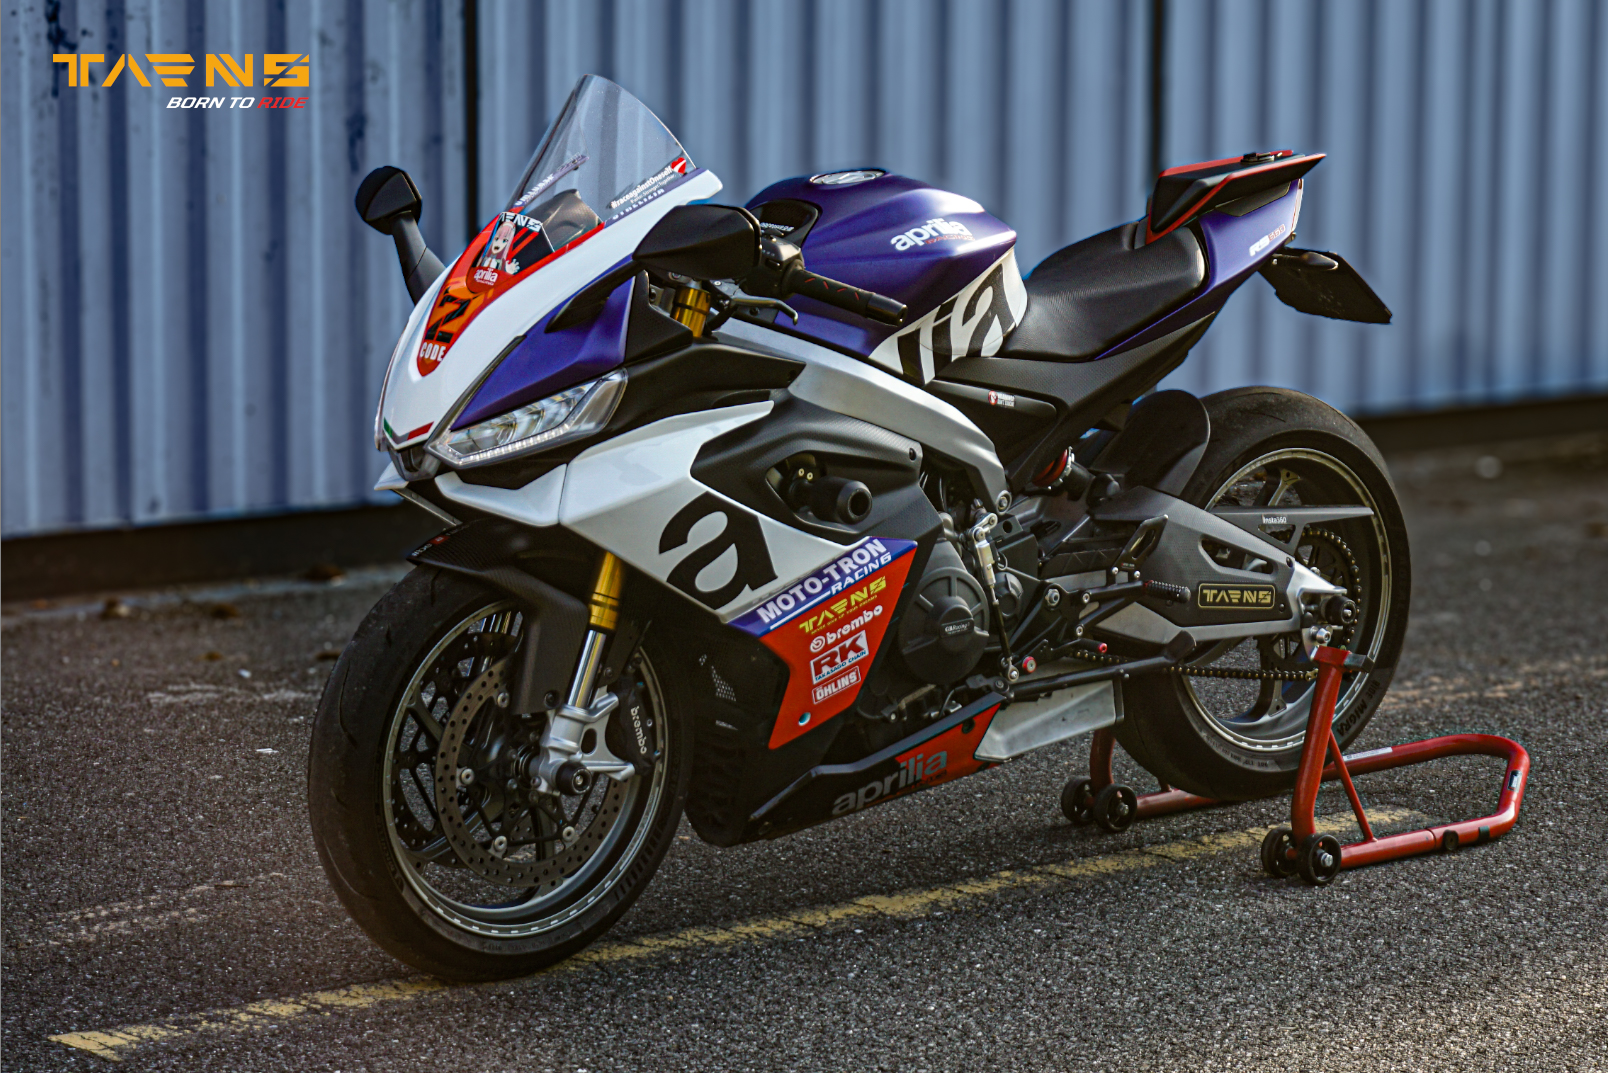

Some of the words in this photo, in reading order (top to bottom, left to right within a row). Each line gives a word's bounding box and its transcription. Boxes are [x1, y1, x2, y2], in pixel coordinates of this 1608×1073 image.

[890, 217, 973, 251] aprilia
[420, 342, 447, 362] CODE
[1262, 516, 1287, 524] Insta360
[658, 491, 779, 610] a
[756, 538, 888, 624] MOTO-TRON
[830, 552, 892, 596] RACING
[799, 576, 887, 633] TAENS
[1202, 589, 1272, 604] TAENS
[826, 605, 883, 645] brembo
[813, 633, 866, 677] RK
[815, 661, 847, 681] TAKASAGO
[848, 649, 867, 664] CHAIN
[815, 670, 858, 701] ÖHLINS
[630, 705, 647, 755] brembo
[832, 750, 948, 816] aprilia
